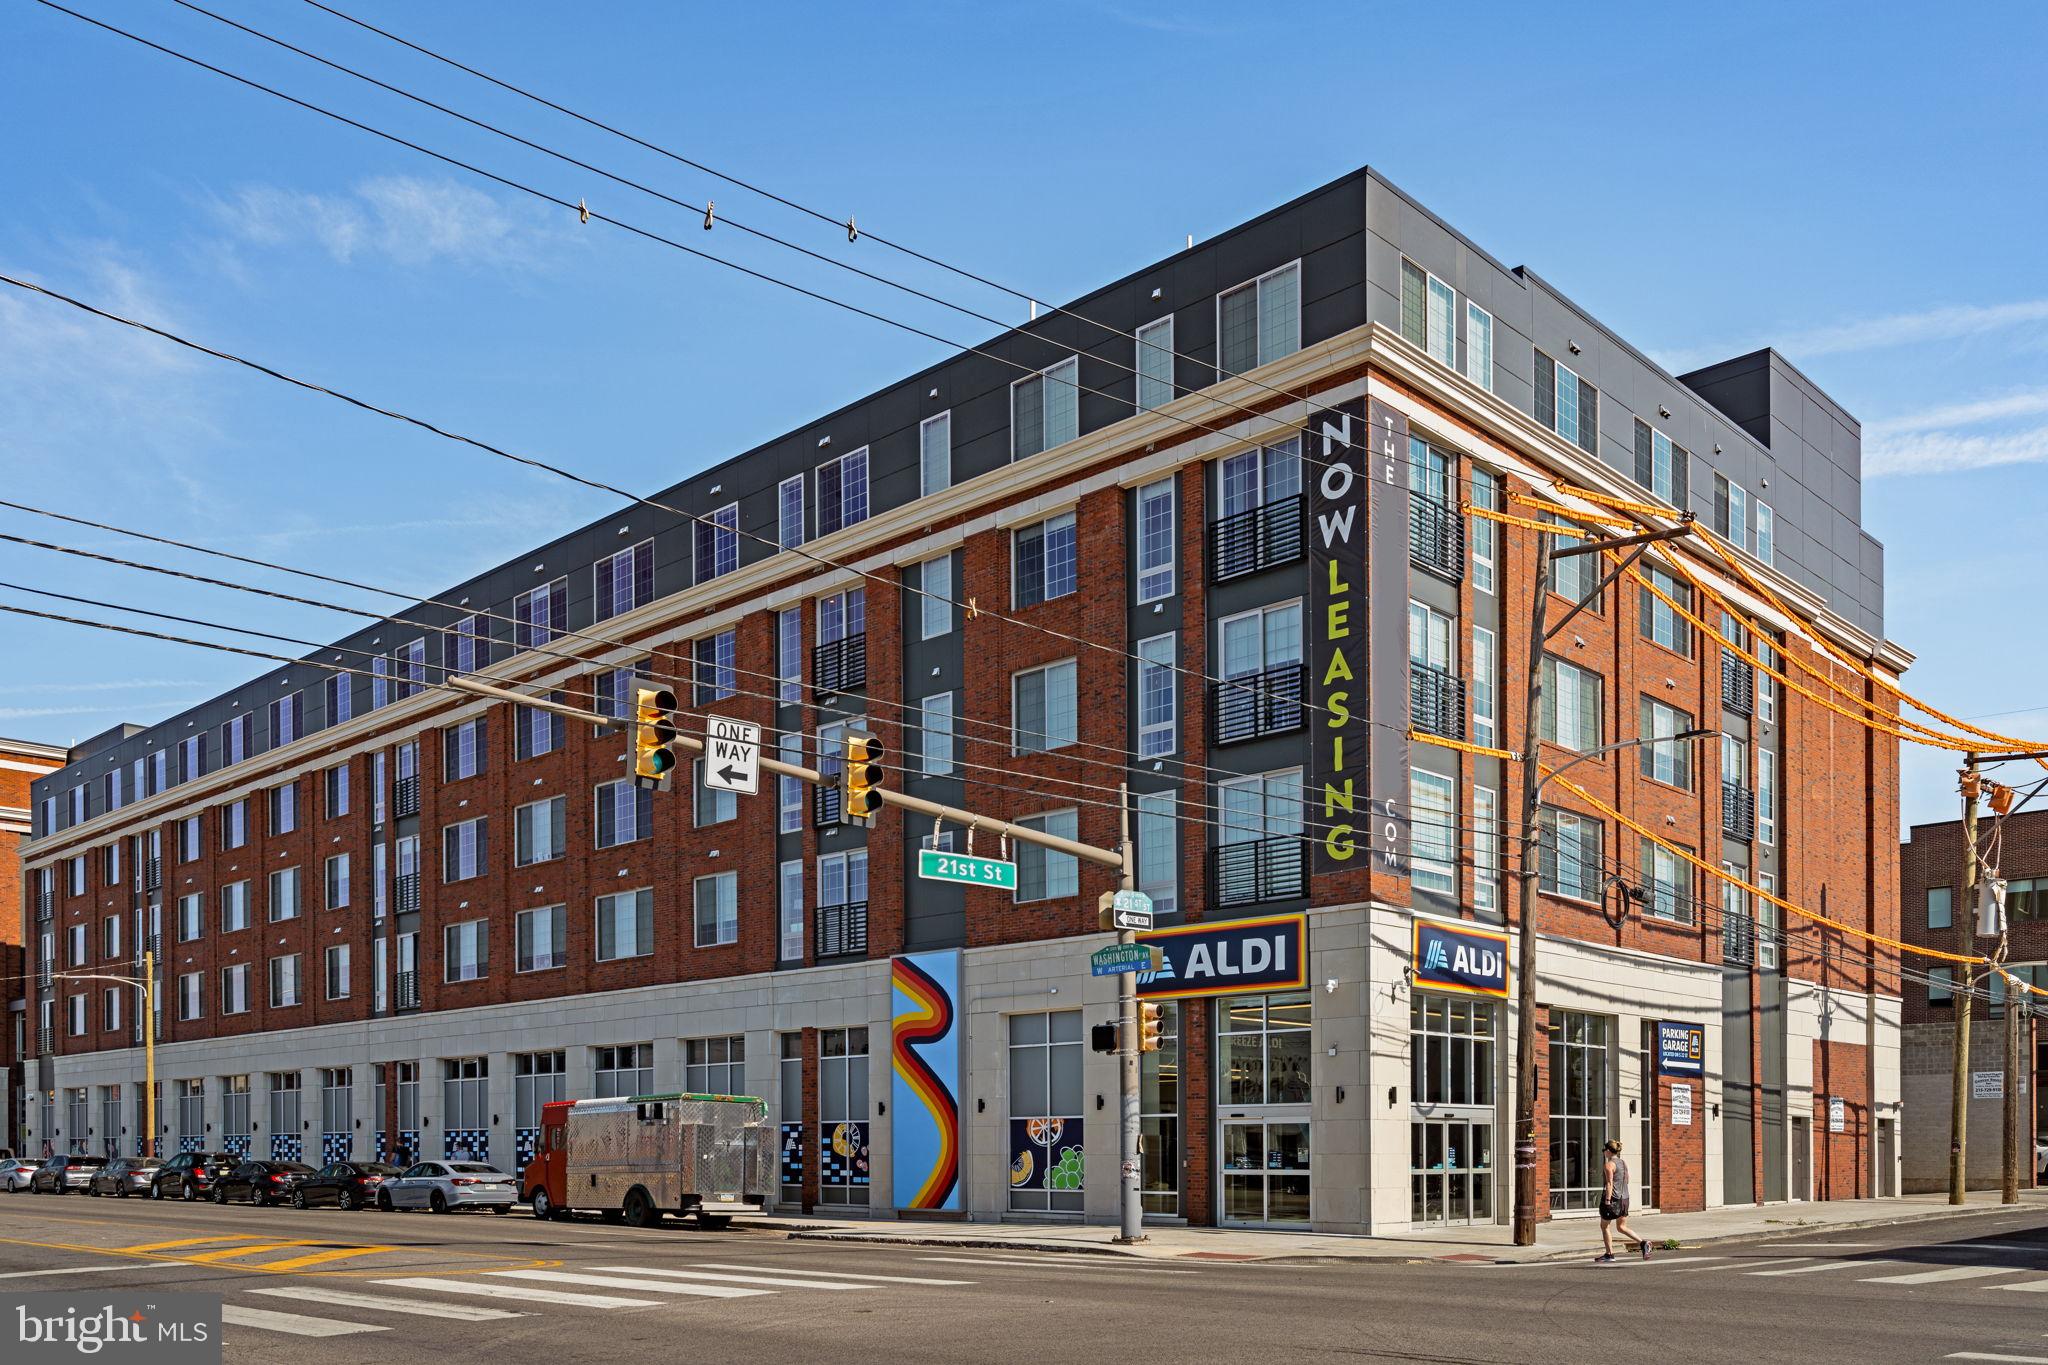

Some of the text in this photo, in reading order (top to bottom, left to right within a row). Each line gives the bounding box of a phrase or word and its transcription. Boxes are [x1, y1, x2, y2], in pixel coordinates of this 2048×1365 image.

[1384, 416, 1395, 486] THE
[1318, 412, 1356, 862] NOW LEASING
[716, 722, 752, 742] ONE
[716, 741, 751, 763] WAY
[1385, 799, 1397, 867] COM
[938, 858, 1003, 881] 21st St
[1126, 915, 1148, 925] ONE WAY
[1092, 950, 1139, 966] WASHINGTON
[1108, 964, 1135, 973] ARTERIAL
[1141, 962, 1146, 970] E
[1184, 935, 1286, 979] ALDI
[1453, 945, 1502, 978] ALDI
[1662, 1027, 1689, 1040] PARKING
[1662, 1039, 1689, 1052] GARAGE
